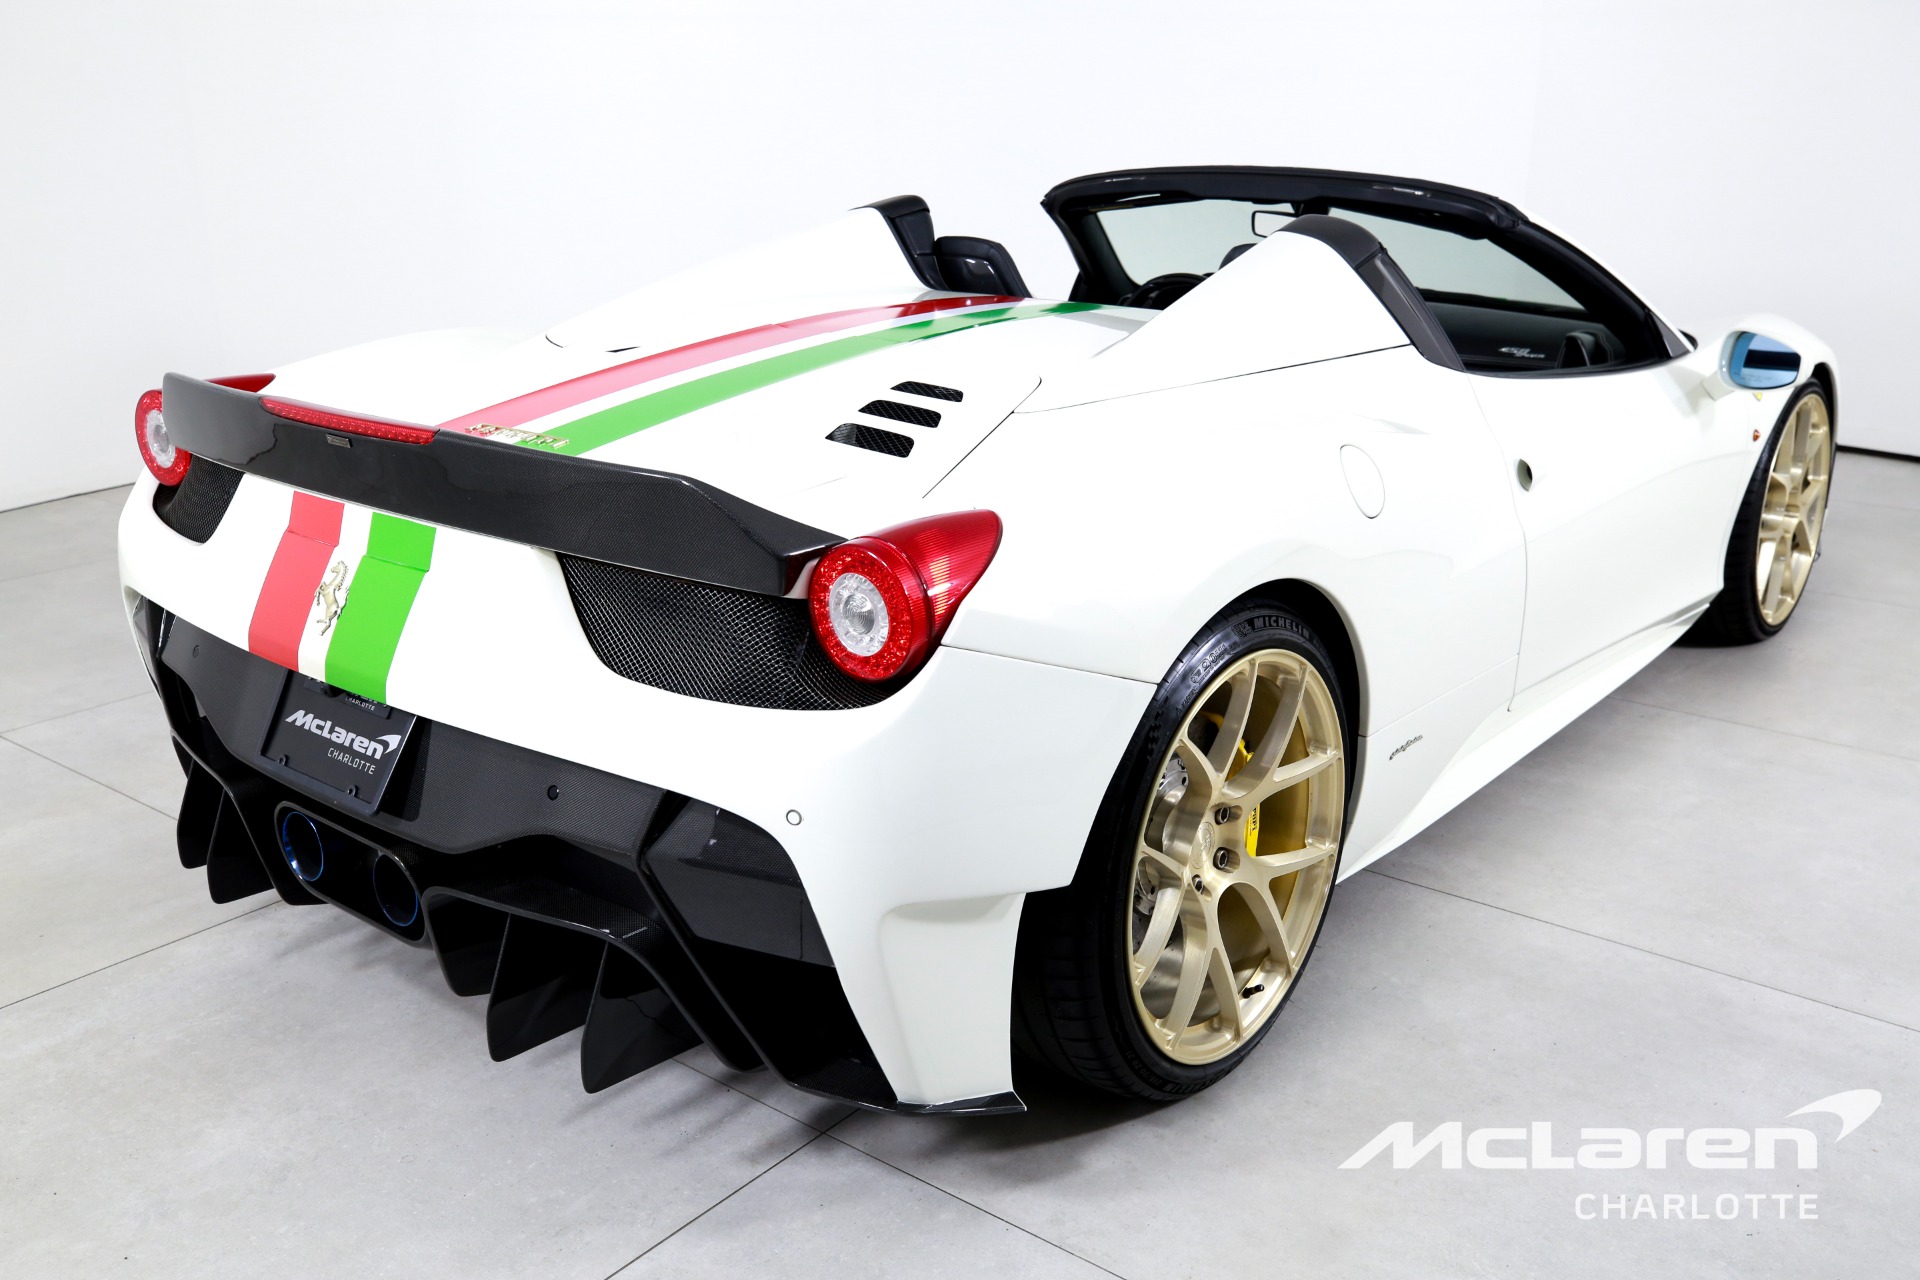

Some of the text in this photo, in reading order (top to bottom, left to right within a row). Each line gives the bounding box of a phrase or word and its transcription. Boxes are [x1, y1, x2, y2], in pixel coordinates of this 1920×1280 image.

[1253, 616, 1310, 640] MICHELIN
[285, 709, 384, 760] McLaren
[327, 747, 376, 775] CHARLOTTE
